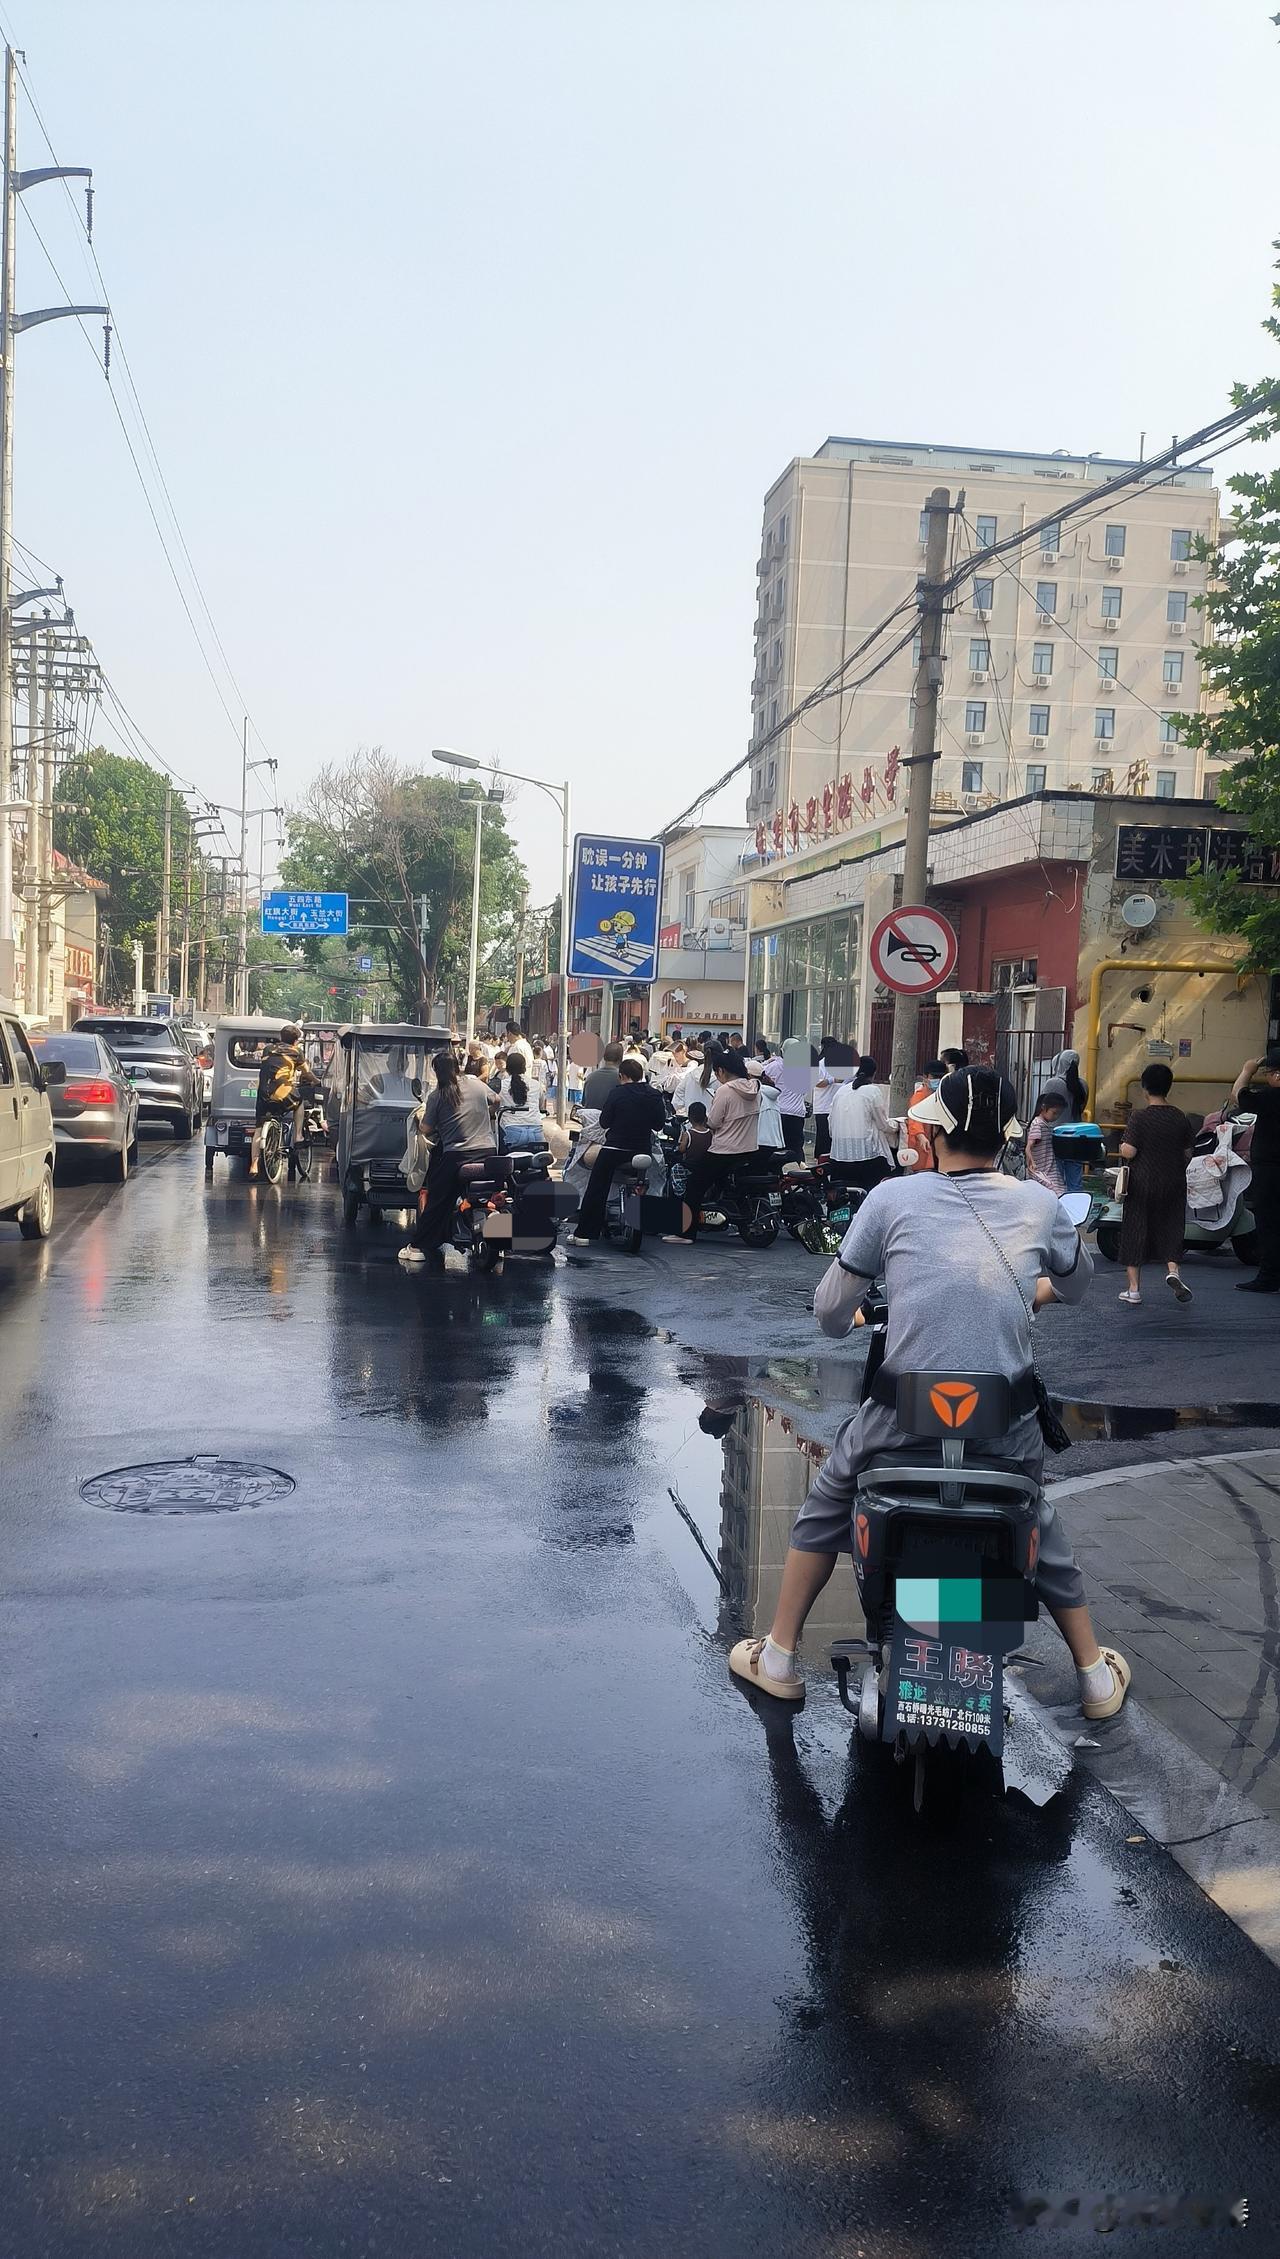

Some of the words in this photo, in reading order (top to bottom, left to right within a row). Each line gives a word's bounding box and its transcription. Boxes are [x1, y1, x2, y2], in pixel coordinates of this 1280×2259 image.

[581, 847, 648, 870] 耽误一分钟
[591, 873, 657, 896] 让孩子先行
[288, 895, 322, 903] 五四东路
[264, 908, 298, 916] 红旗大街
[310, 909, 343, 917] 玉兰大街
[899, 1638, 994, 1691] 王晓
[896, 1712, 991, 1736] 电话:13731280855
